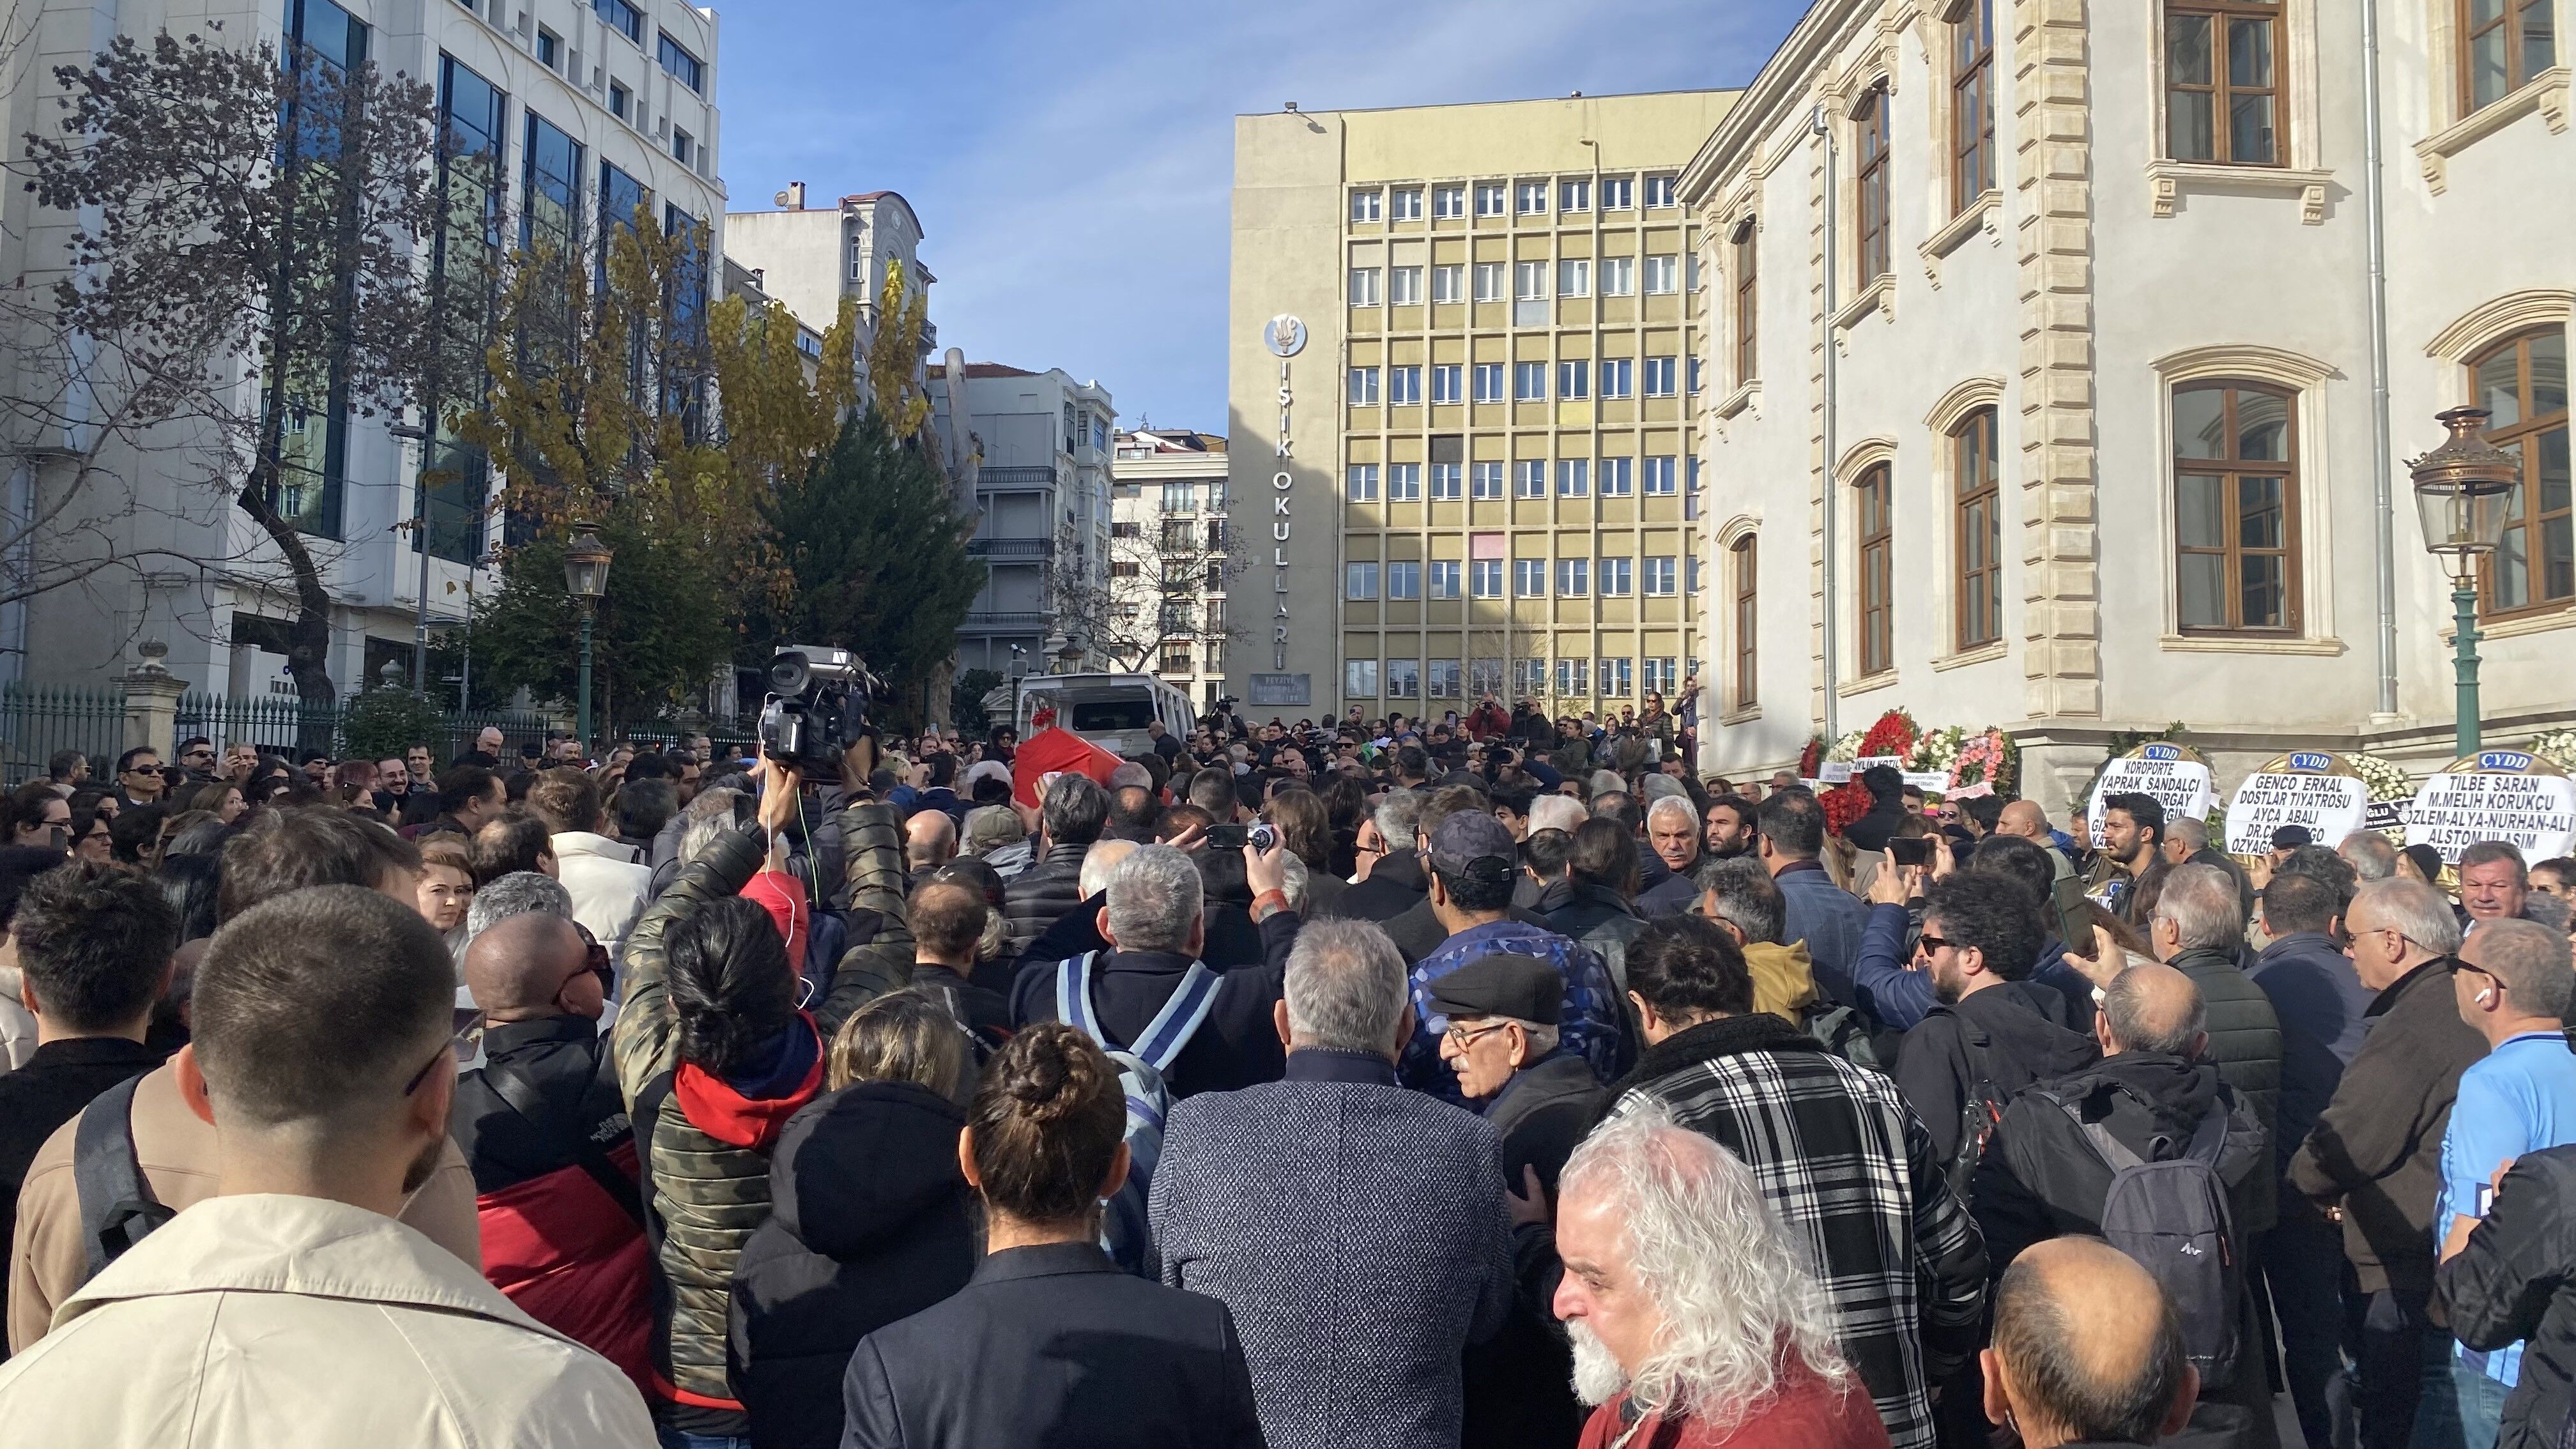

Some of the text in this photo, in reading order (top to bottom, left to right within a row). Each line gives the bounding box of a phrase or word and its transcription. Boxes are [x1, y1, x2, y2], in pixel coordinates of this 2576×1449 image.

[1273, 361, 1292, 670] IŞIK OKULLARI
[2145, 746, 2178, 760] ÇYDD
[2124, 761, 2175, 776] KOROPORTE
[2291, 754, 2329, 769] ÇYDD
[2481, 754, 2529, 769] ÇYDD
[2101, 776, 2201, 792] YAPRAK SANDALCI
[2255, 775, 2343, 792] GENCO ERKAL
[2493, 777, 2540, 793] SARAN
[2239, 790, 2287, 806] DOSTLAR
[2285, 809, 2319, 825] ABALI
[2366, 808, 2389, 818] ĞLU
[2427, 829, 2482, 845] ALSTOM
